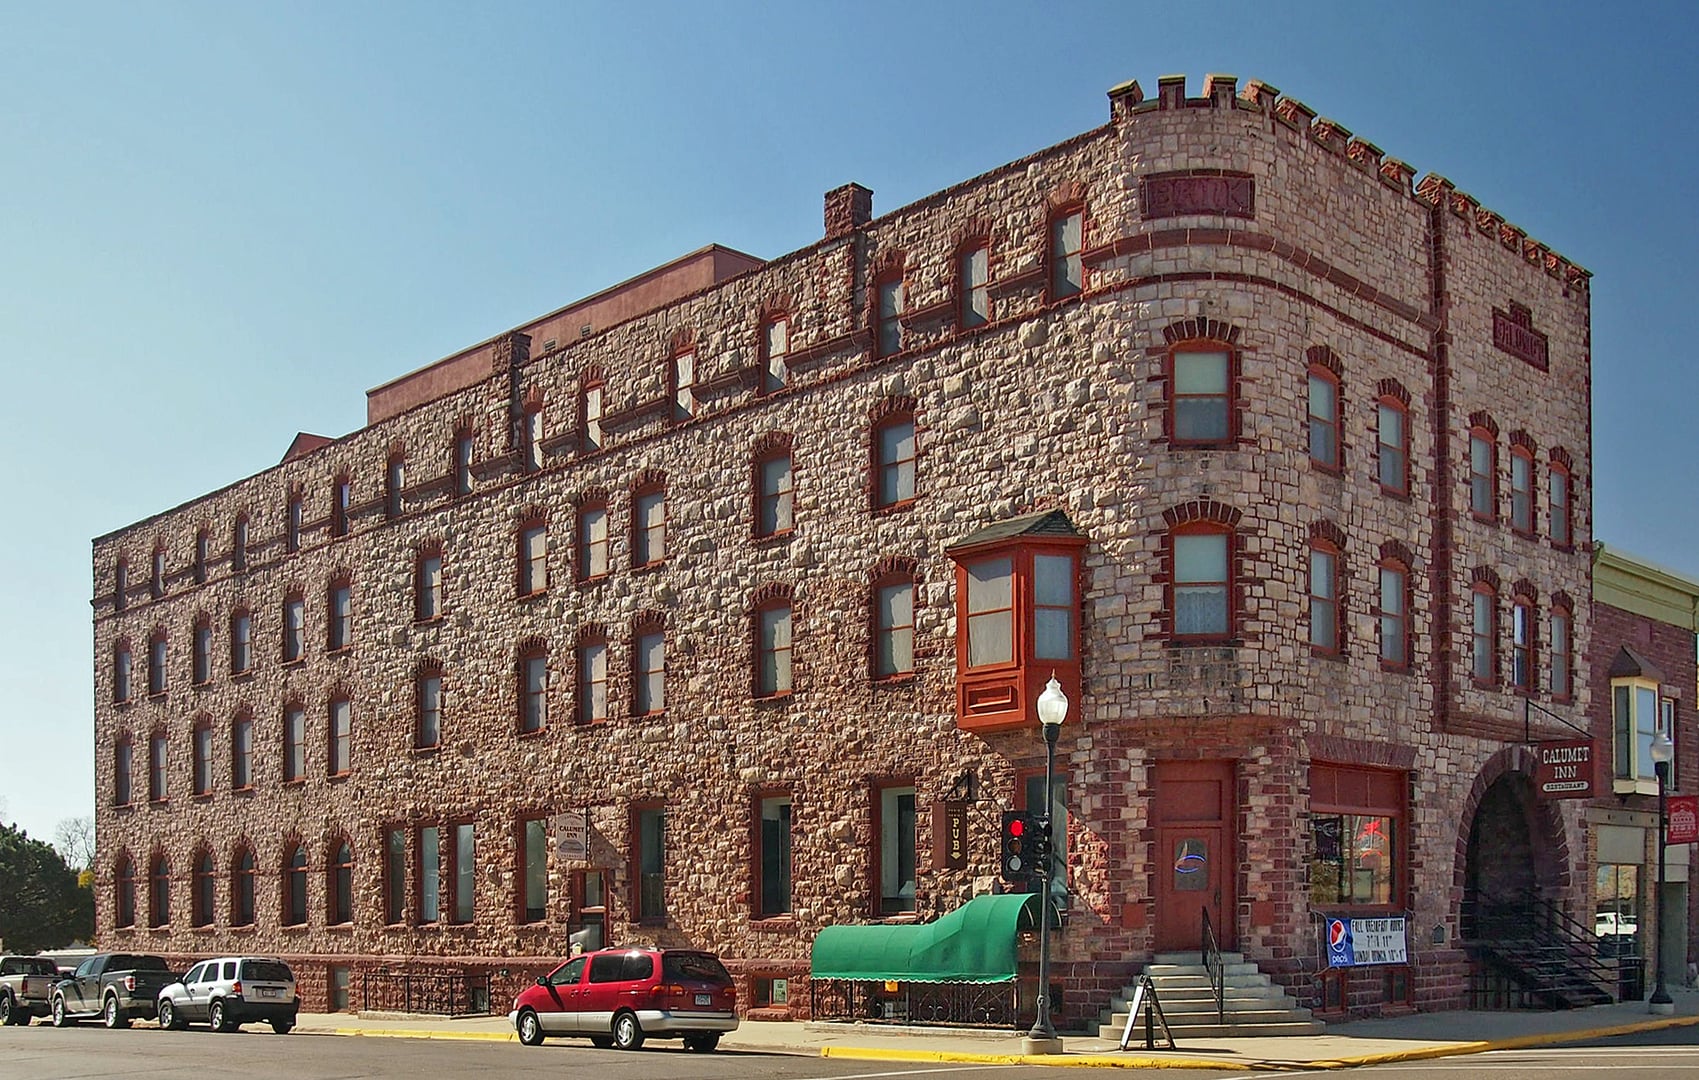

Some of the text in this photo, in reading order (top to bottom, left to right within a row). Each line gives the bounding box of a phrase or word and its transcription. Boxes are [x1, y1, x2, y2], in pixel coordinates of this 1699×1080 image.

[1150, 179, 1249, 209] BANK
[1543, 747, 1589, 764] CALUMET
[1554, 765, 1577, 779] INN
[952, 818, 960, 850] PUB
